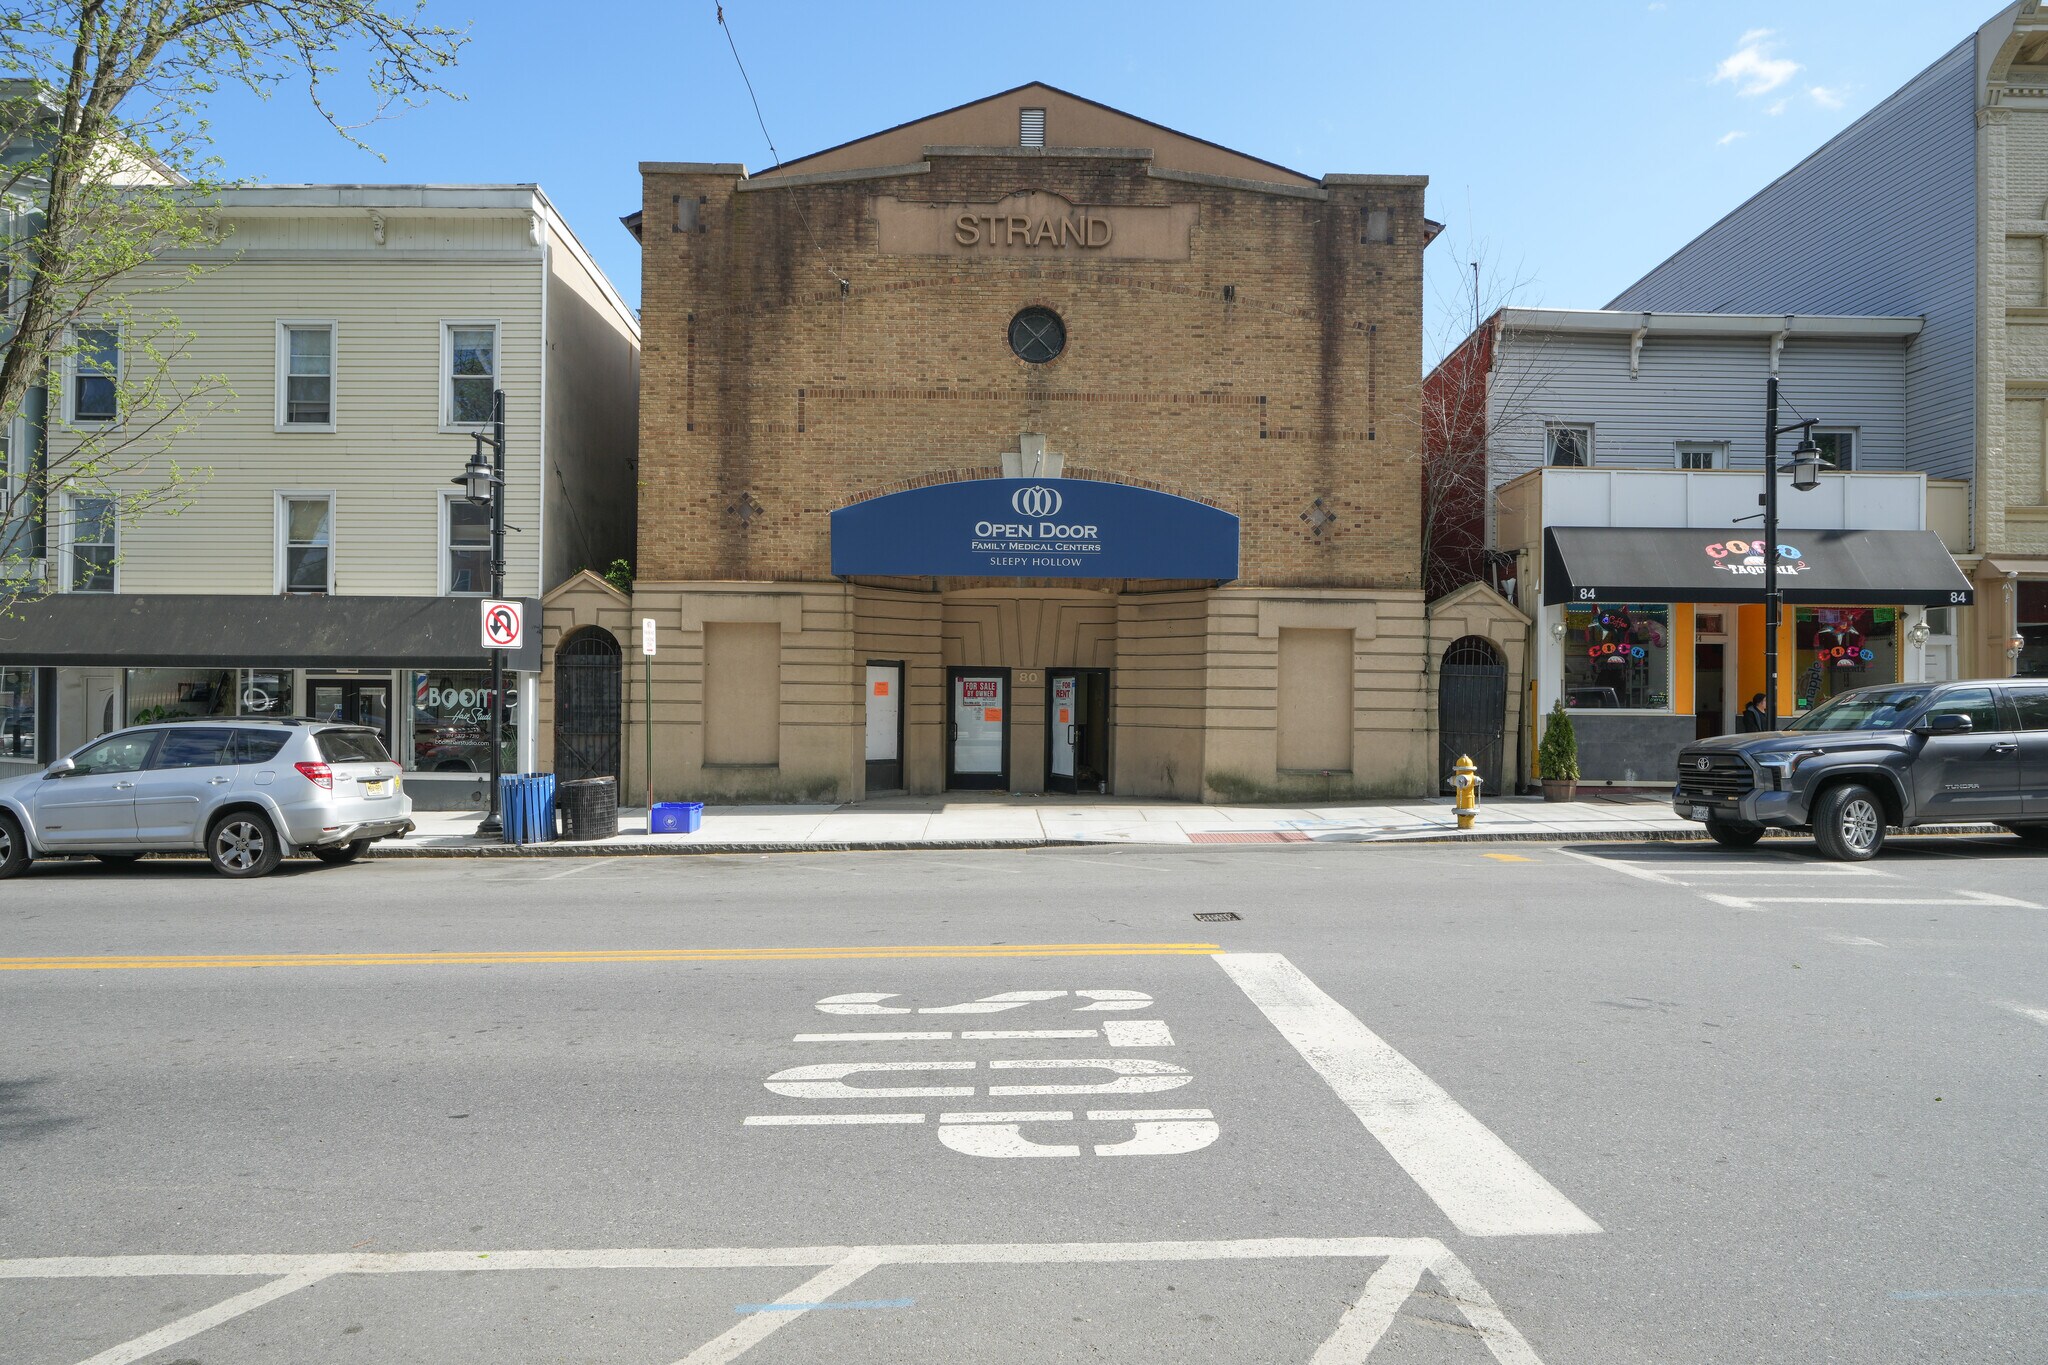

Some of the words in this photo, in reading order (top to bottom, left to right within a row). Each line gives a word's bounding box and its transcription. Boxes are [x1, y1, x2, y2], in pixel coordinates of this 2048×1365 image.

[955, 213, 1112, 248] STRAND
[975, 521, 1032, 538] OPEN
[1040, 522, 1098, 539] DOOR
[971, 541, 1006, 550] FAMILY
[1009, 542, 1053, 551] MEDICAL
[1055, 543, 1101, 552] CENTERS
[990, 557, 1028, 566] SLEEPY
[1032, 558, 1082, 567] HOLLOW
[1580, 588, 1596, 599] 84
[1950, 592, 1966, 603] 84
[1609, 615, 1628, 629] Coffee
[1588, 643, 1645, 659] COCO
[1817, 646, 1874, 661] COCO
[1019, 672, 1038, 683] 80
[979, 683, 996, 691] SALE
[1062, 681, 1071, 689] FOR
[1056, 690, 1070, 699] RENT
[444, 708, 470, 724] Hair
